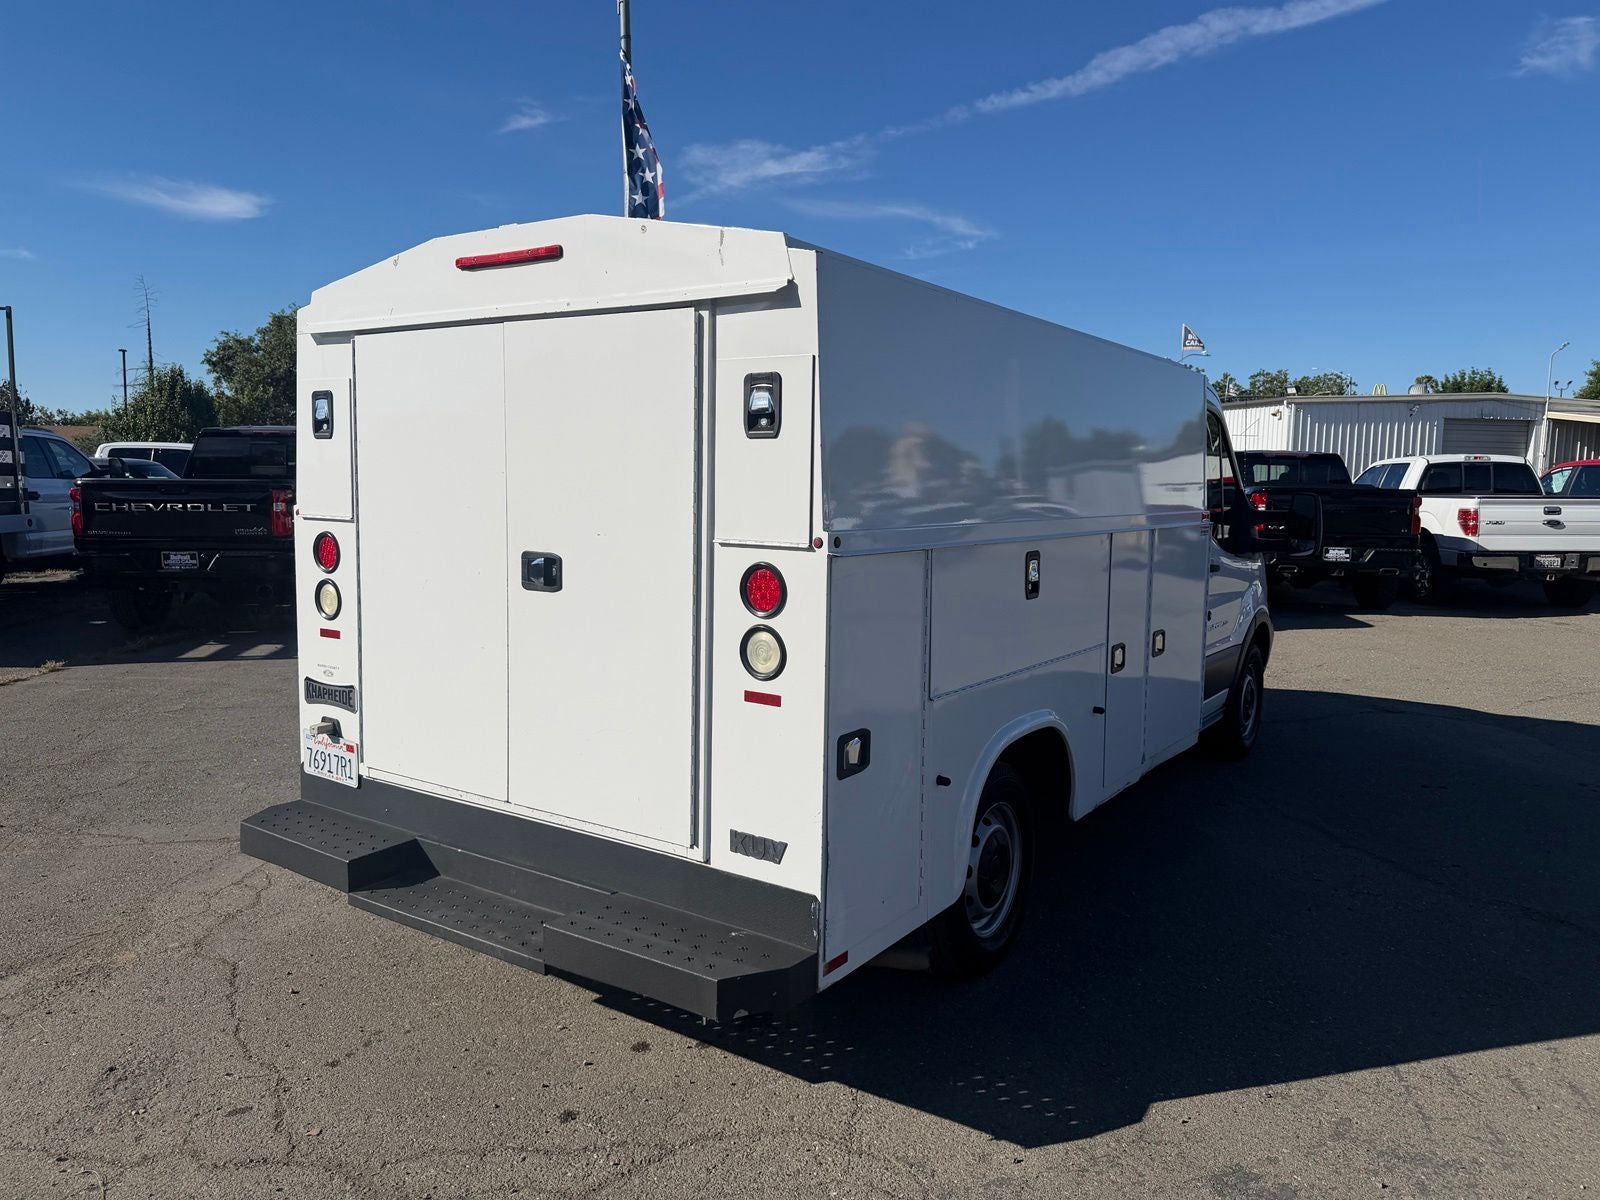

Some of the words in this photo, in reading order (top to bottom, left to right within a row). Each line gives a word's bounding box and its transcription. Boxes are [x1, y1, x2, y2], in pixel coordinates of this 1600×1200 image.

[94, 502, 257, 513] CHEVROLET
[306, 746, 354, 780] 76917R1
[730, 828, 788, 865] KUV
